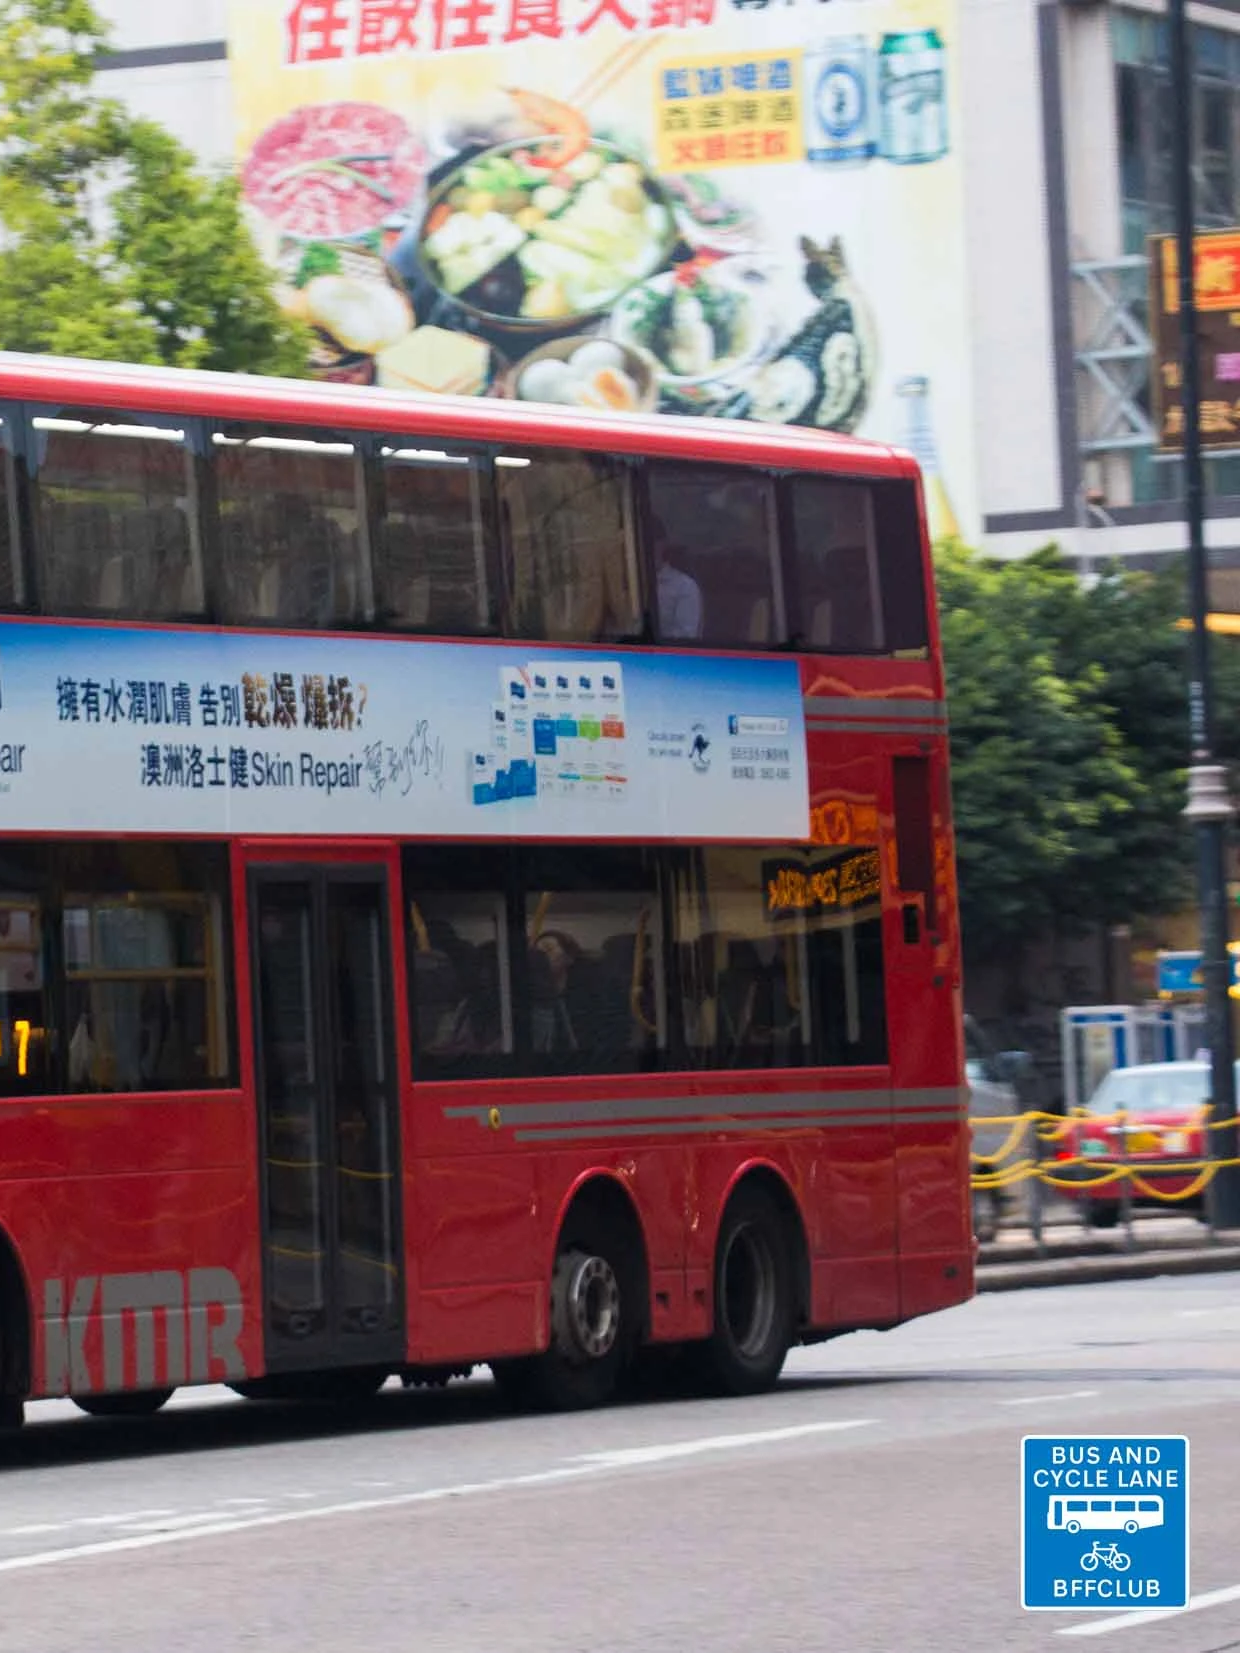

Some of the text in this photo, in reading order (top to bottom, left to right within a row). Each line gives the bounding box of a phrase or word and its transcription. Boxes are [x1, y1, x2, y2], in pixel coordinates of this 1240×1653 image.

[56, 676, 192, 728] 擁有水潤肌膚
[140, 743, 249, 788] 澳洲洛士健
[252, 750, 294, 788] Skin
[300, 752, 362, 795] Repair
[14, 1019, 31, 1077] 7
